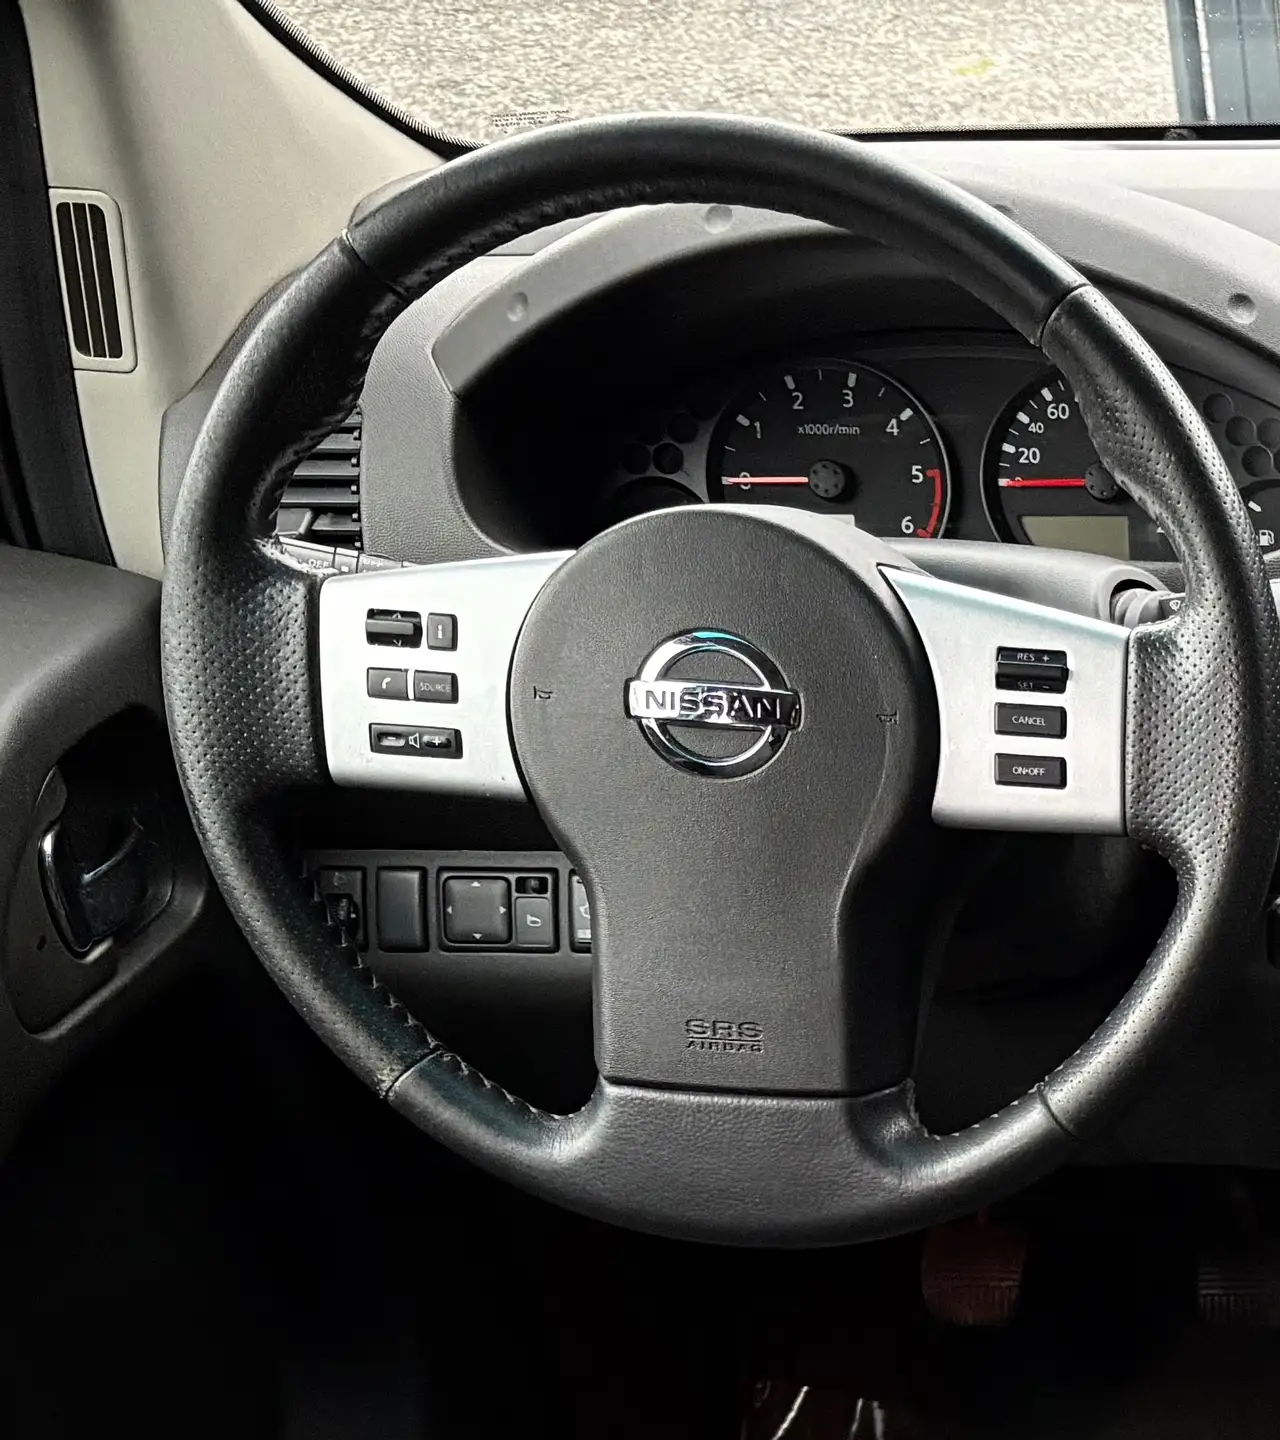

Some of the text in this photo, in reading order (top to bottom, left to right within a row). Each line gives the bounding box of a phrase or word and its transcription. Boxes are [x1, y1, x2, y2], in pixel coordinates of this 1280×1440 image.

[792, 391, 804, 410] 2
[842, 389, 855, 408] 3
[1047, 403, 1070, 420] 60
[753, 420, 761, 439] 1
[885, 417, 900, 436] 4
[1027, 422, 1045, 434] 40
[1018, 448, 1041, 464] 20
[911, 465, 923, 484] 5
[900, 515, 914, 534] 6
[1016, 652, 1035, 662] RES
[645, 687, 781, 720] NISSAN
[1012, 715, 1046, 726] CANCEL
[685, 1018, 764, 1039] SRS
[685, 1040, 765, 1054] AIRBAG
